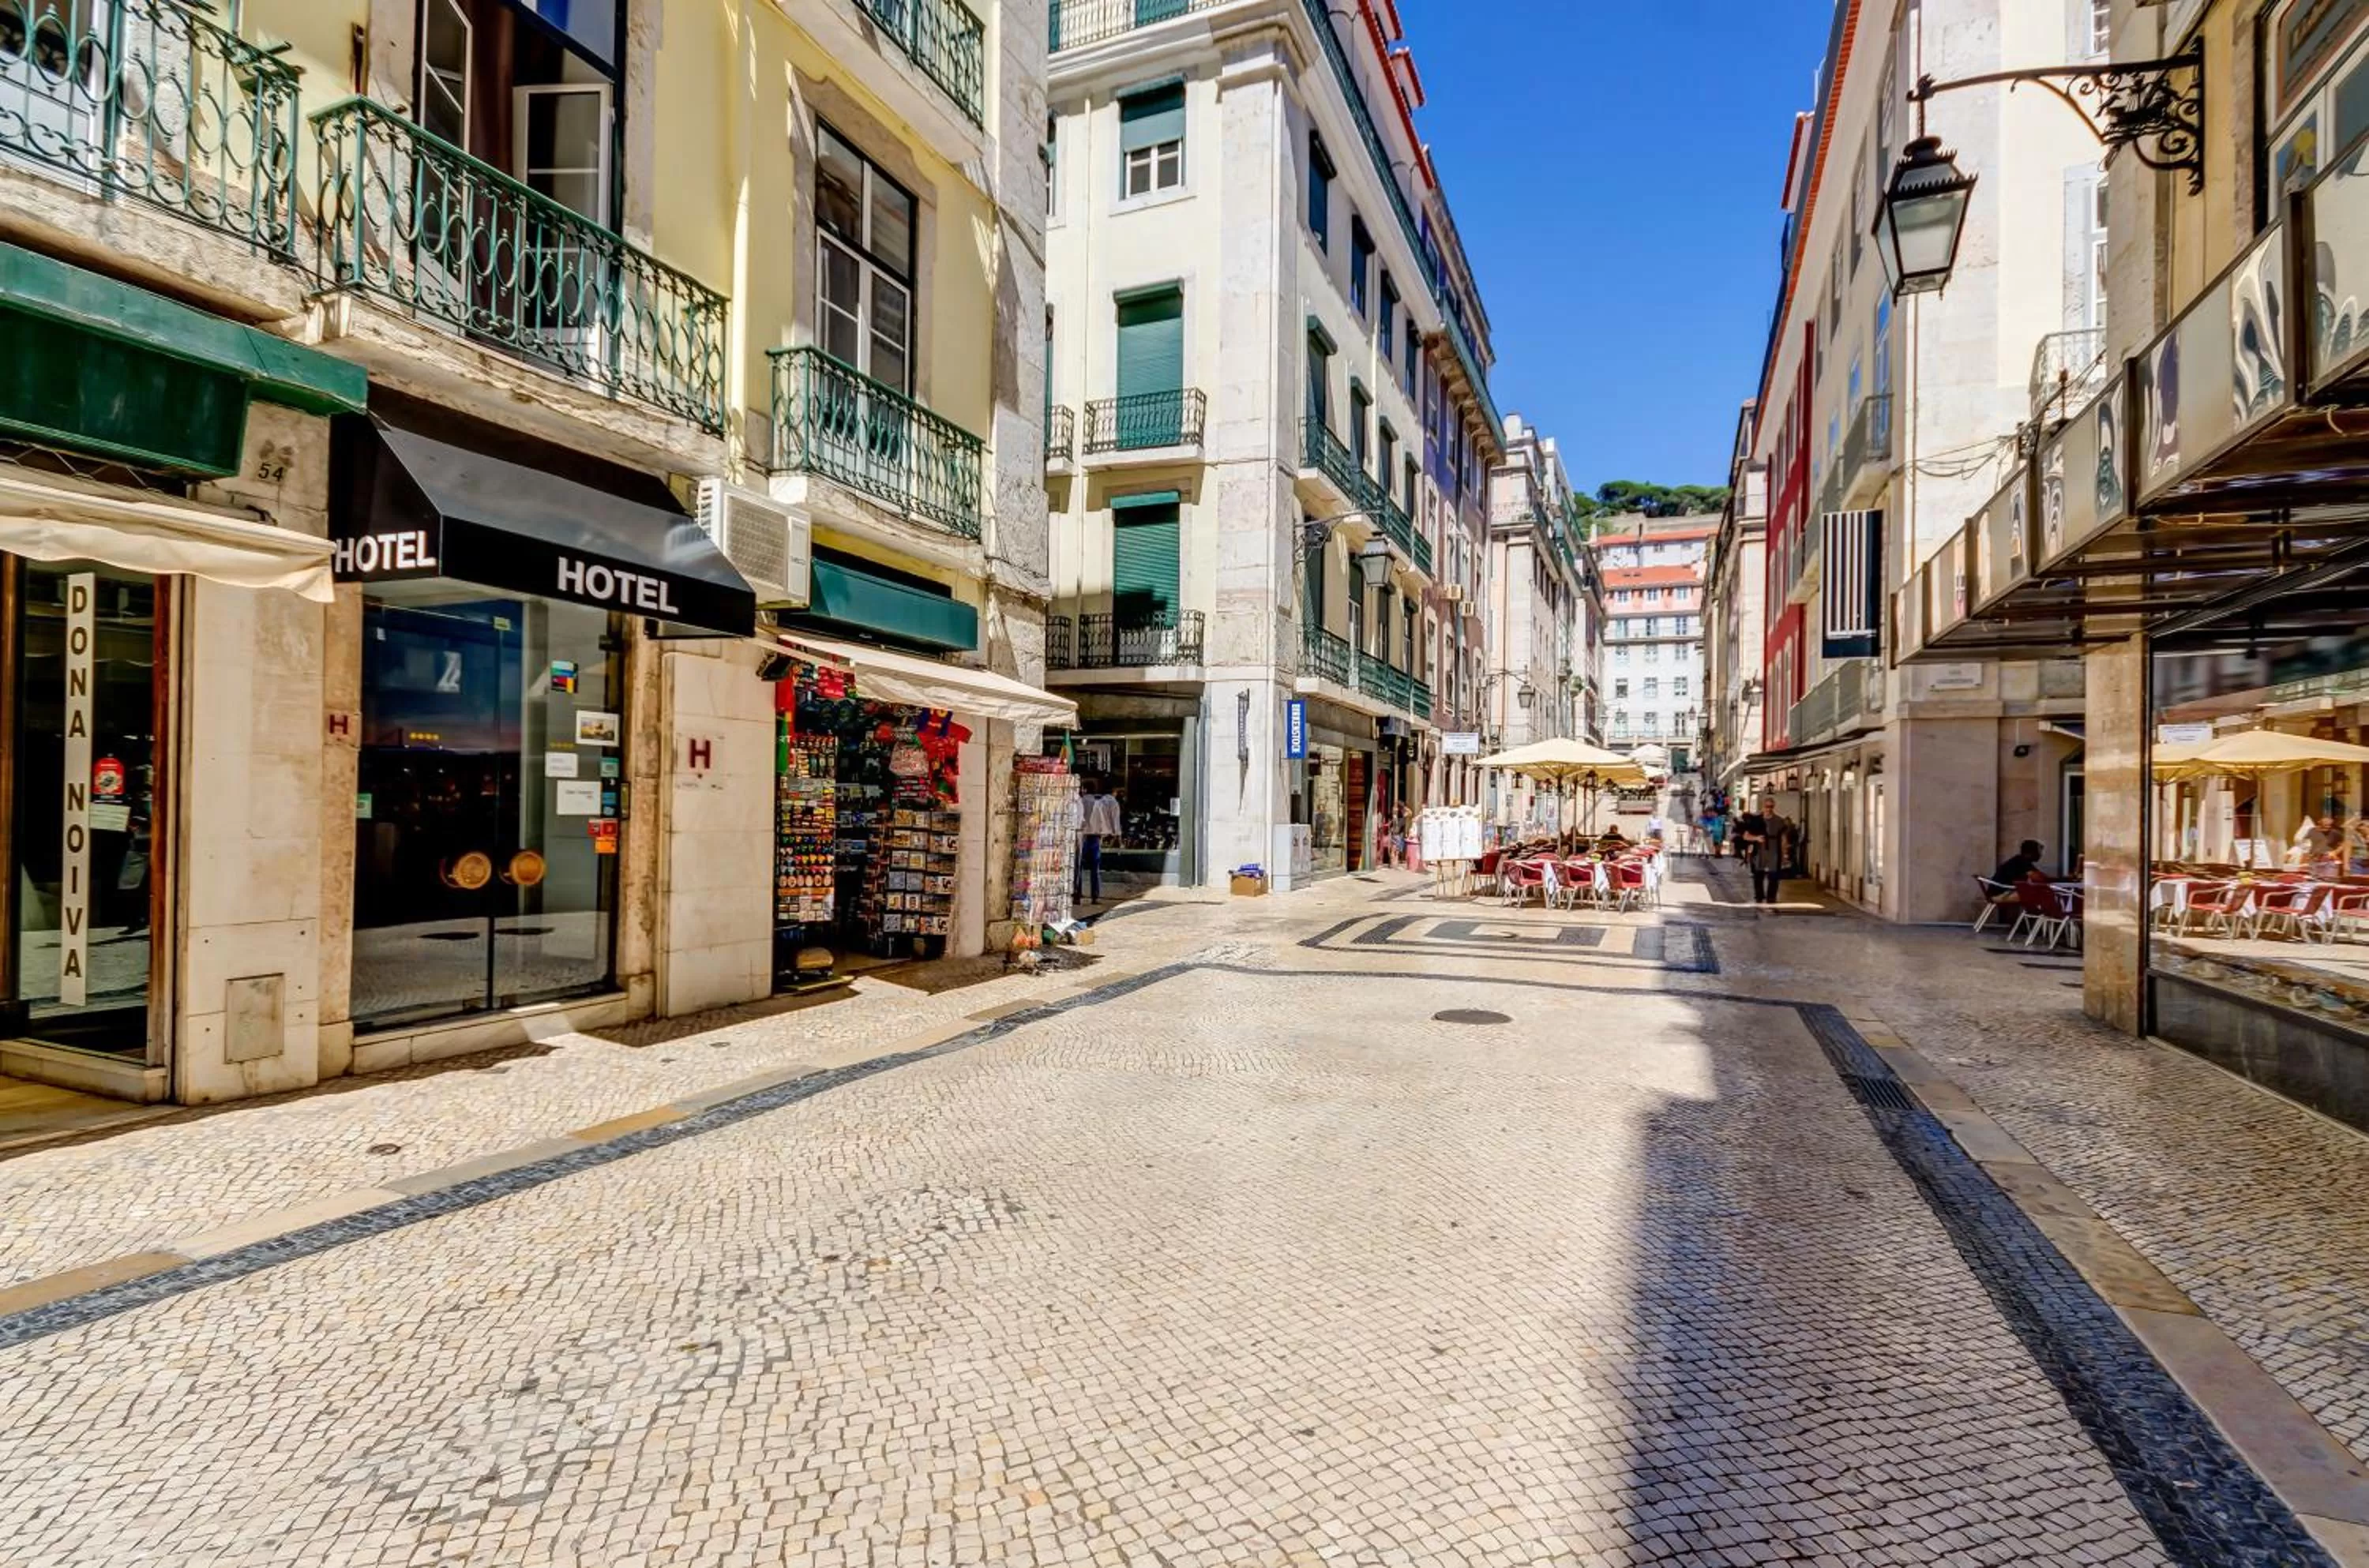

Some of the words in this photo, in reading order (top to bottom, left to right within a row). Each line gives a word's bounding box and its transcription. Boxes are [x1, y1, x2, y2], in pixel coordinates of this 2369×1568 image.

[258, 462, 283, 481] 54
[335, 531, 437, 572] HOTEL
[558, 556, 679, 614] HOTEL
[68, 586, 88, 737] DONA
[329, 715, 348, 734] H
[689, 738, 711, 769] H
[63, 782, 84, 978] NOIVA
